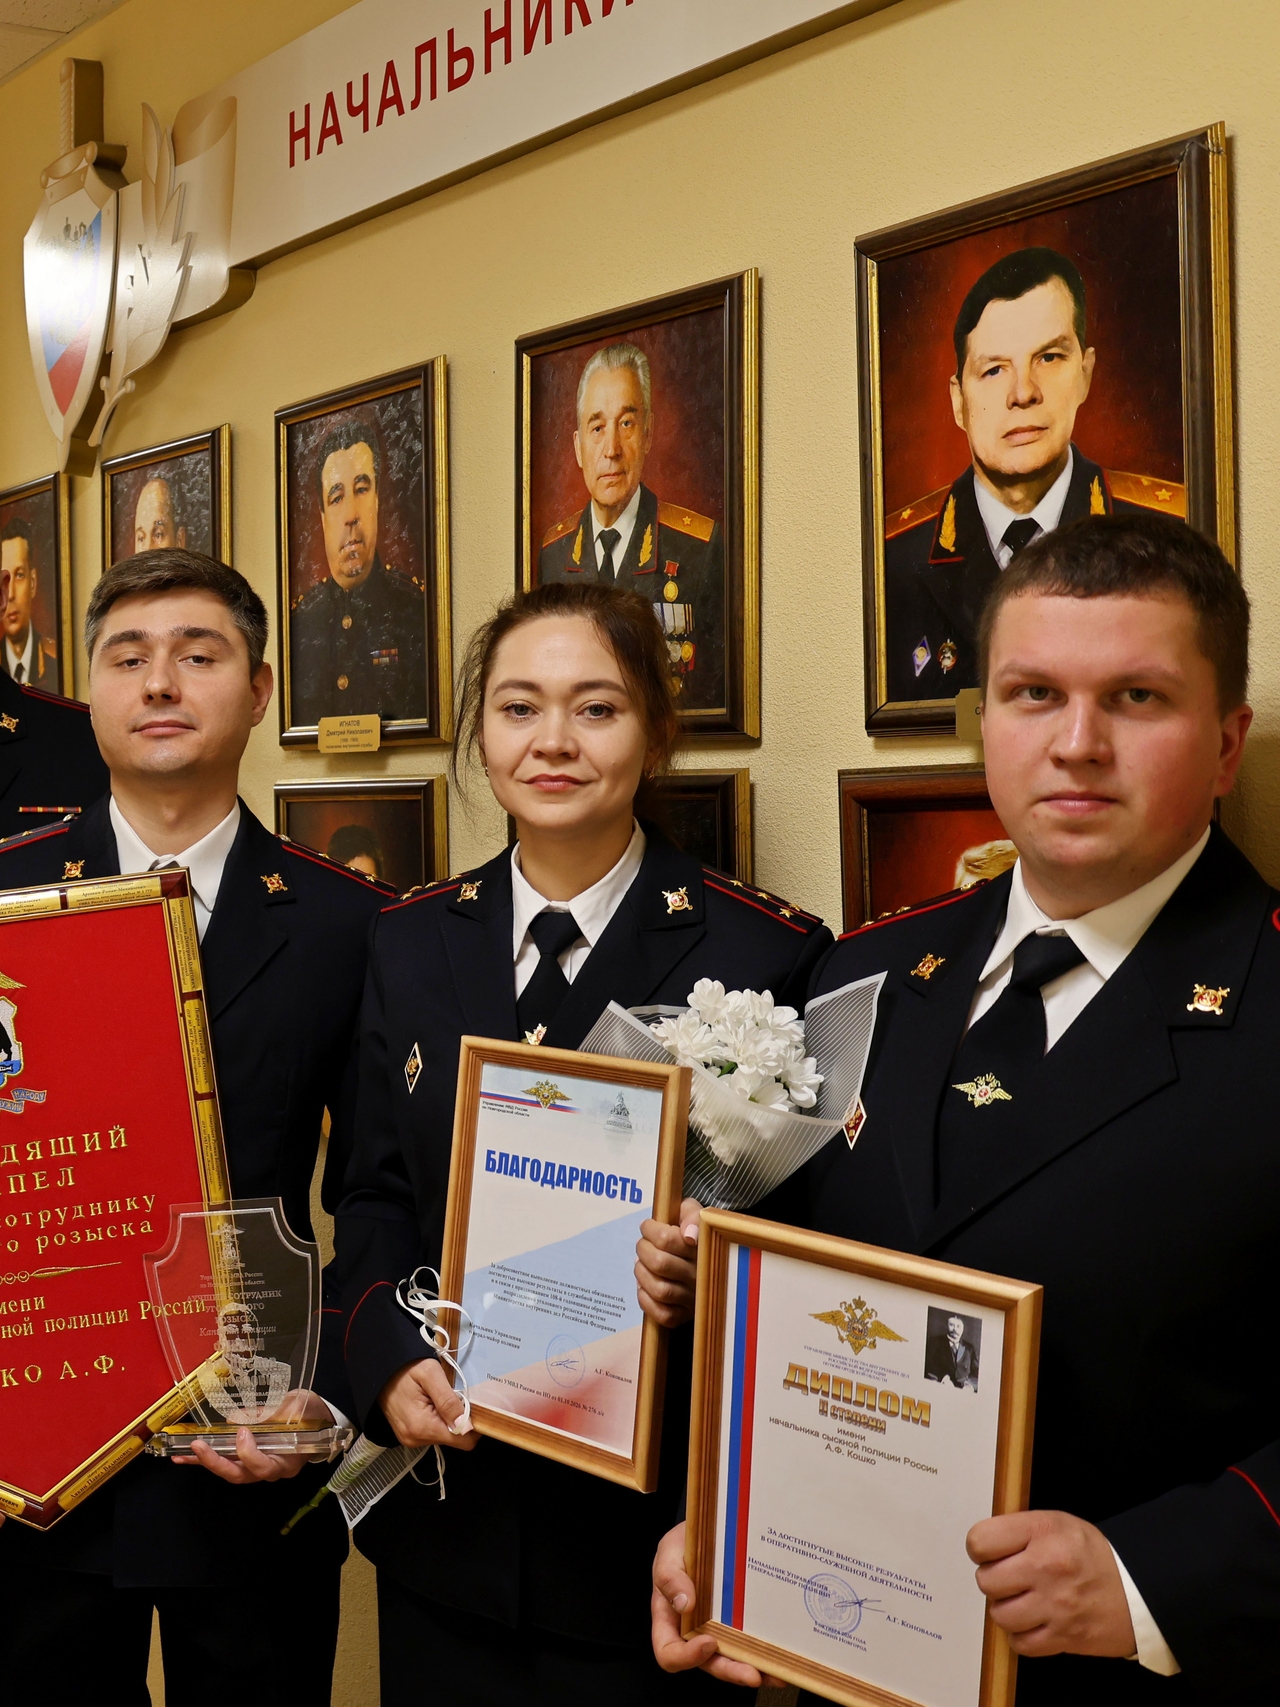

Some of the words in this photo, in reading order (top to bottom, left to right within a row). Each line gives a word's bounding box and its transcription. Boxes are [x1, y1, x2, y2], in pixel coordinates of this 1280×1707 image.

[14, 1090, 44, 1101] НАРОДУ
[485, 1149, 642, 1204] БЛАГОДАРНОСТЬ
[36, 1219, 153, 1254] розыска
[44, 1308, 129, 1332] полиции
[139, 1298, 206, 1321] России
[60, 1355, 125, 1380] А.Ф.
[605, 1370, 632, 1383] Коновалов
[782, 1362, 931, 1428] ДИПЛОМ
[819, 1398, 829, 1417] II
[768, 1417, 819, 1438] начальника
[821, 1433, 859, 1450] сыскной
[861, 1445, 900, 1463] полиции
[903, 1456, 937, 1474] России
[836, 1428, 865, 1441] имени
[825, 1442, 843, 1455] А.Ф.
[846, 1448, 876, 1465] Кошко
[766, 1537, 867, 1578] ОПЕРАТИВНО-СЛУЖЕБНОЙ
[869, 1573, 932, 1601] ДЕЯТЕЛЬНОСТИ
[778, 1531, 834, 1556] ДОСТИГНУТЫЕ
[835, 1551, 874, 1570] ВЫСОКИЕ
[875, 1565, 925, 1588] РЕЗУЛЬТАТЫ
[886, 1615, 898, 1624] А.Г.
